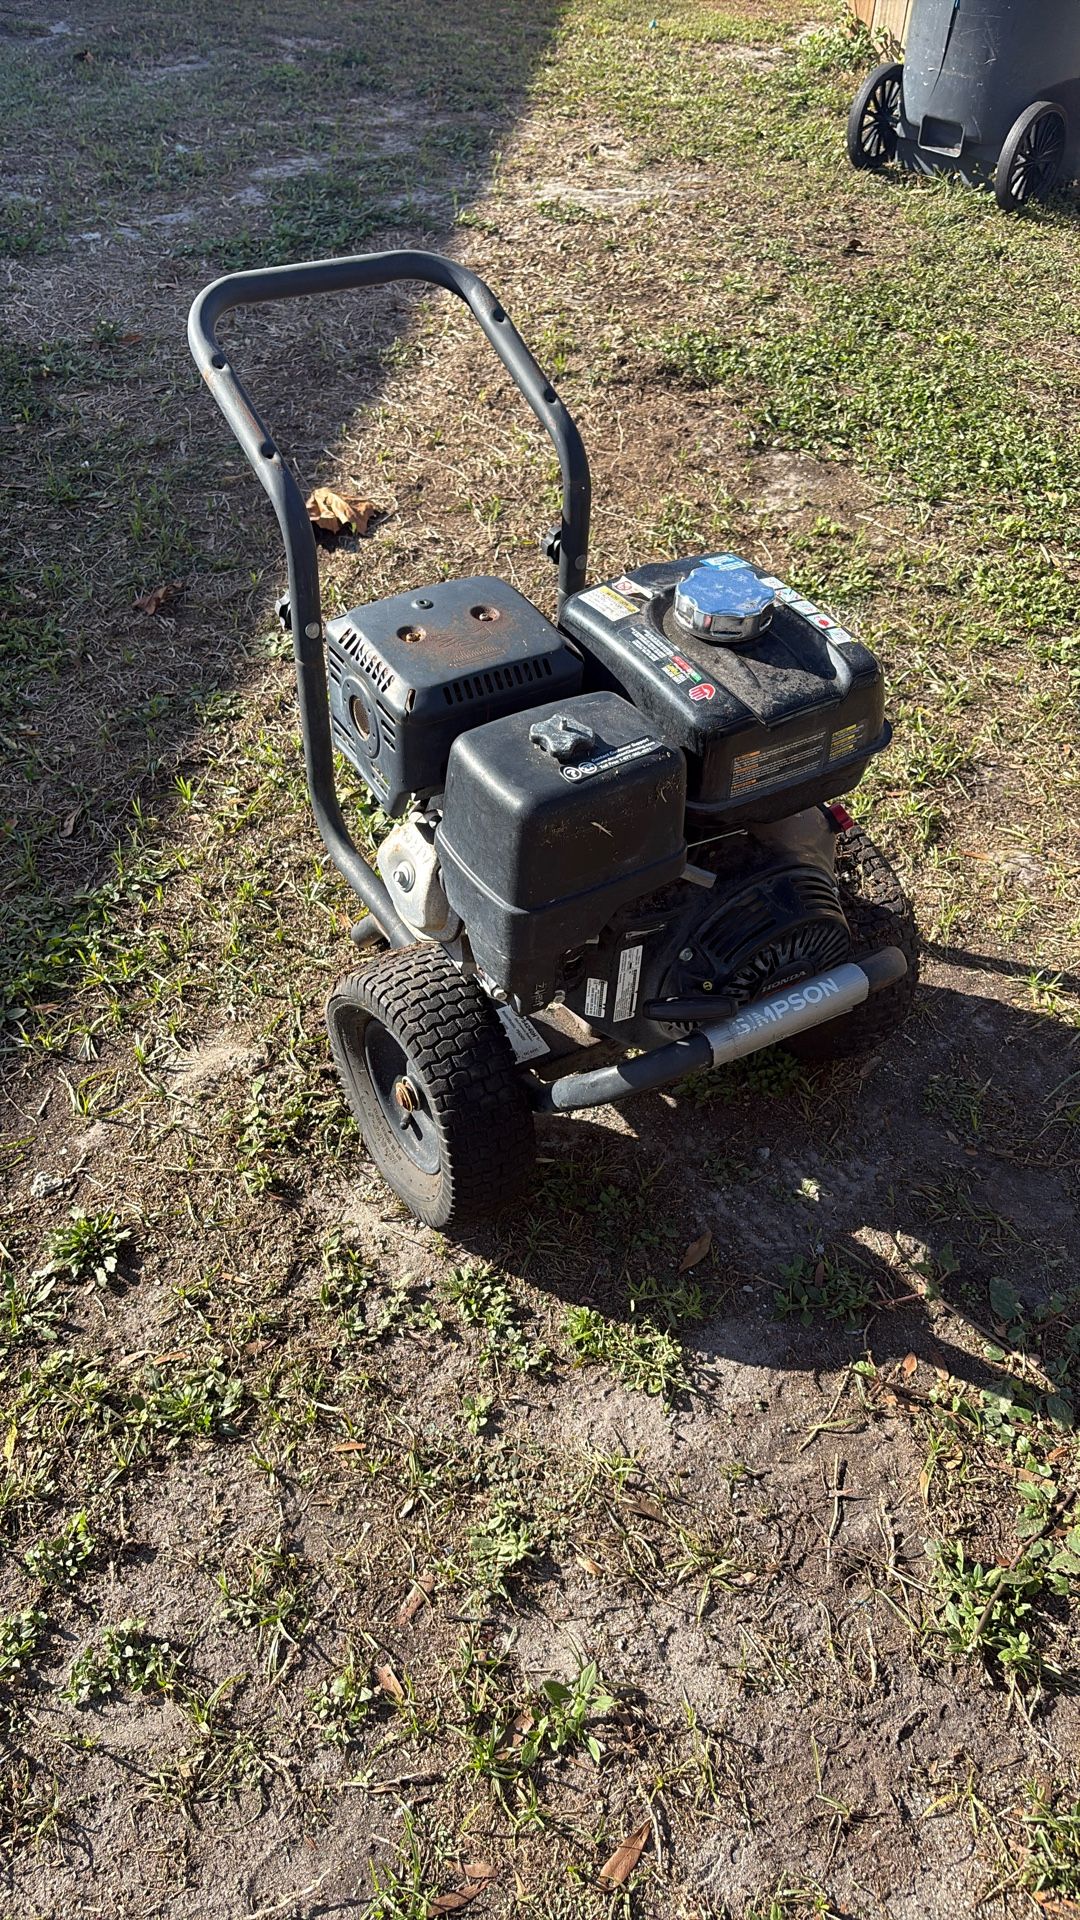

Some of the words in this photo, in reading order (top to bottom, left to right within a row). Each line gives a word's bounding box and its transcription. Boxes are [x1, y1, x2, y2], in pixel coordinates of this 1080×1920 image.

[591, 753, 609, 762] Contact
[631, 738, 649, 747] Support
[761, 970, 807, 992] HONDA
[731, 978, 840, 1035] SIMPSON
